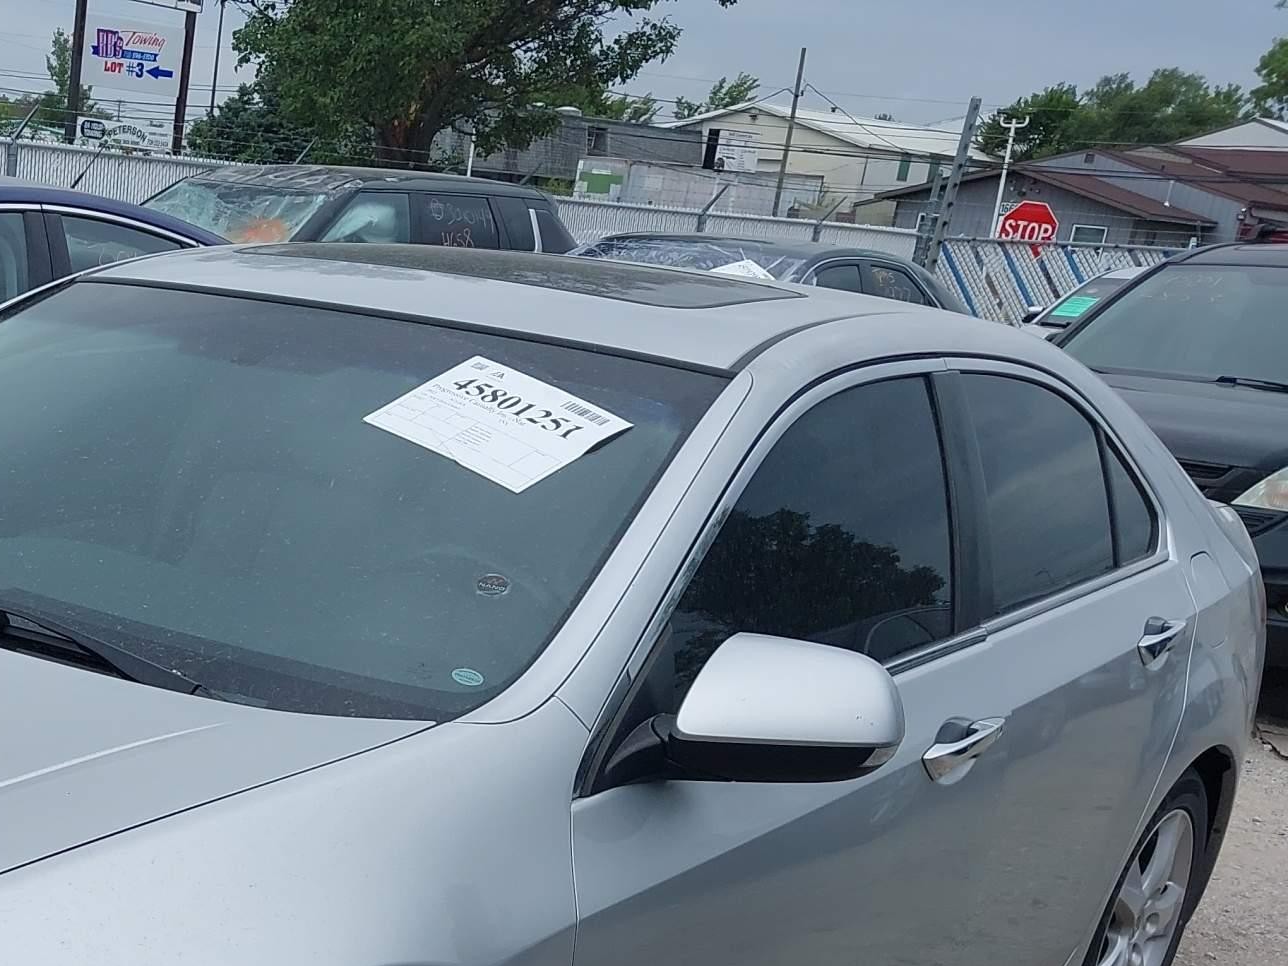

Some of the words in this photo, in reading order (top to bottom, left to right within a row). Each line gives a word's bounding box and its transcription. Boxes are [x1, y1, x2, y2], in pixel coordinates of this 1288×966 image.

[120, 30, 166, 53] Towing
[104, 61, 124, 73] LOT
[126, 61, 145, 78] #3
[107, 124, 148, 143] PETERSON
[1002, 219, 1053, 241] STOP
[452, 378, 585, 440] 45801251
